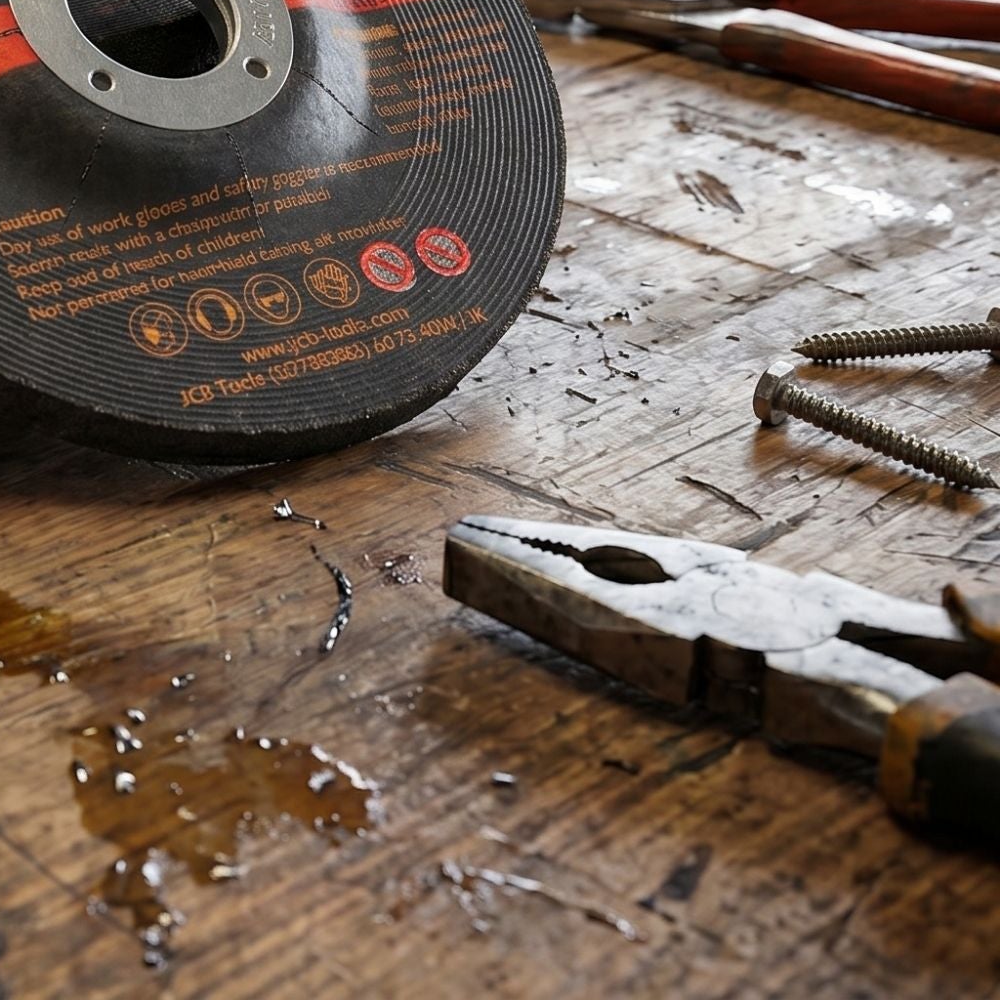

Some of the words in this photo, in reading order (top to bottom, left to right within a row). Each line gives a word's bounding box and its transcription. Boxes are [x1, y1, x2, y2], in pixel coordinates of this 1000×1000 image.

[66, 223, 84, 241] of
[87, 212, 133, 236] work
[191, 184, 220, 208] and
[102, 262, 121, 280] of
[175, 241, 194, 260] of
[114, 231, 152, 252] with
[154, 231, 167, 243] a
